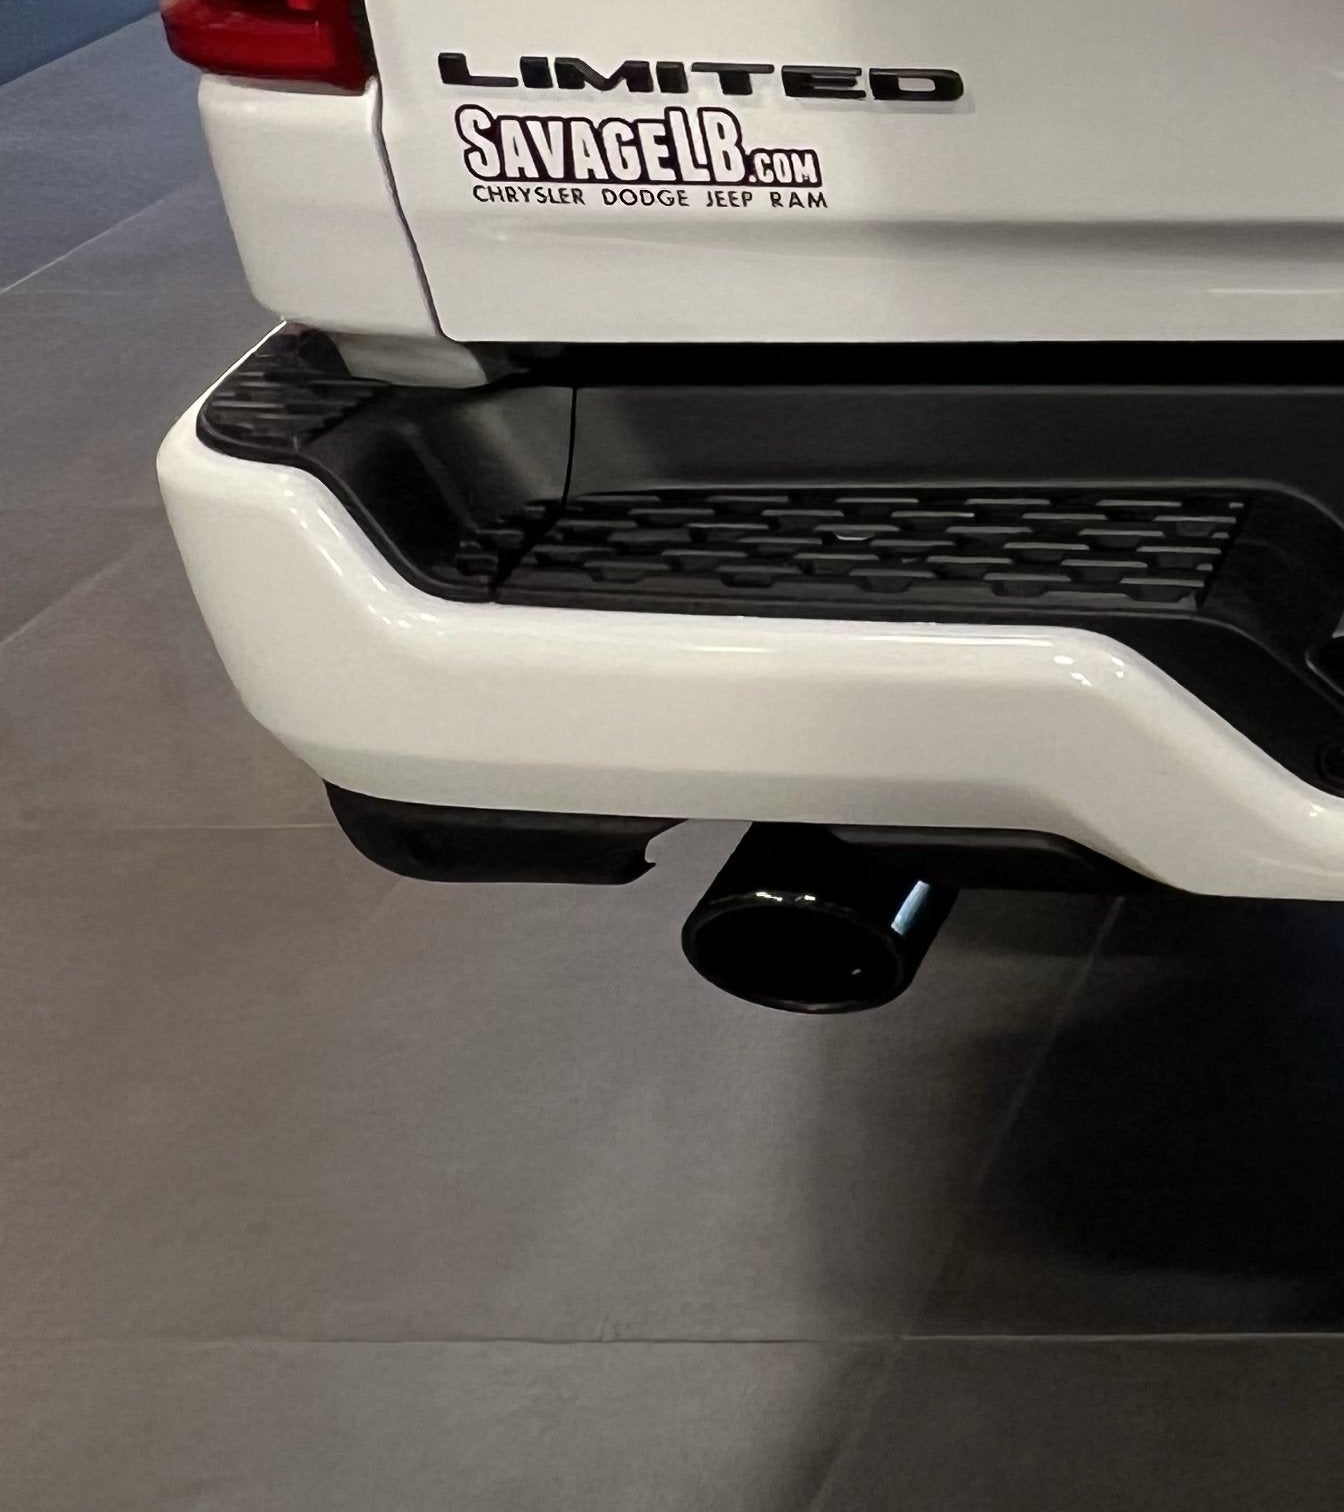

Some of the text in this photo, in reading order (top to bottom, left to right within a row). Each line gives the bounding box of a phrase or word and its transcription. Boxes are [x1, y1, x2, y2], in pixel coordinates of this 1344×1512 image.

[437, 51, 965, 102] LIMITED
[472, 184, 828, 210] CHRYSLER DODGE JEEP RAM
